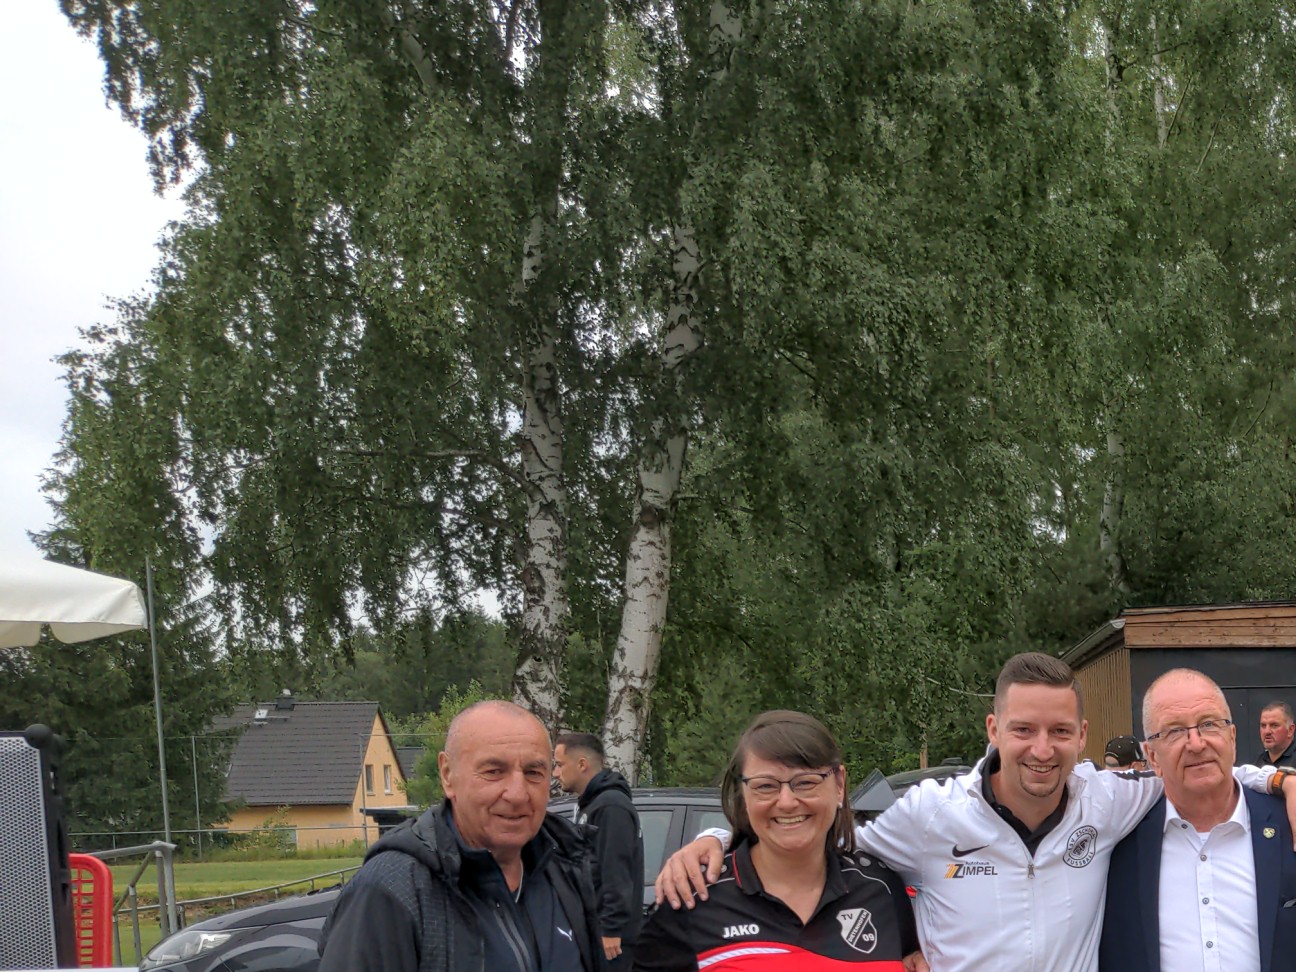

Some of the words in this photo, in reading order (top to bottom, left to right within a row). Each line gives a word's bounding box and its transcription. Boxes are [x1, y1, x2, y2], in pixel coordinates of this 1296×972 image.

[952, 863, 999, 879] ZIMPEL
[841, 913, 853, 921] TV
[722, 923, 760, 939] JAKO
[862, 933, 875, 942] 09
